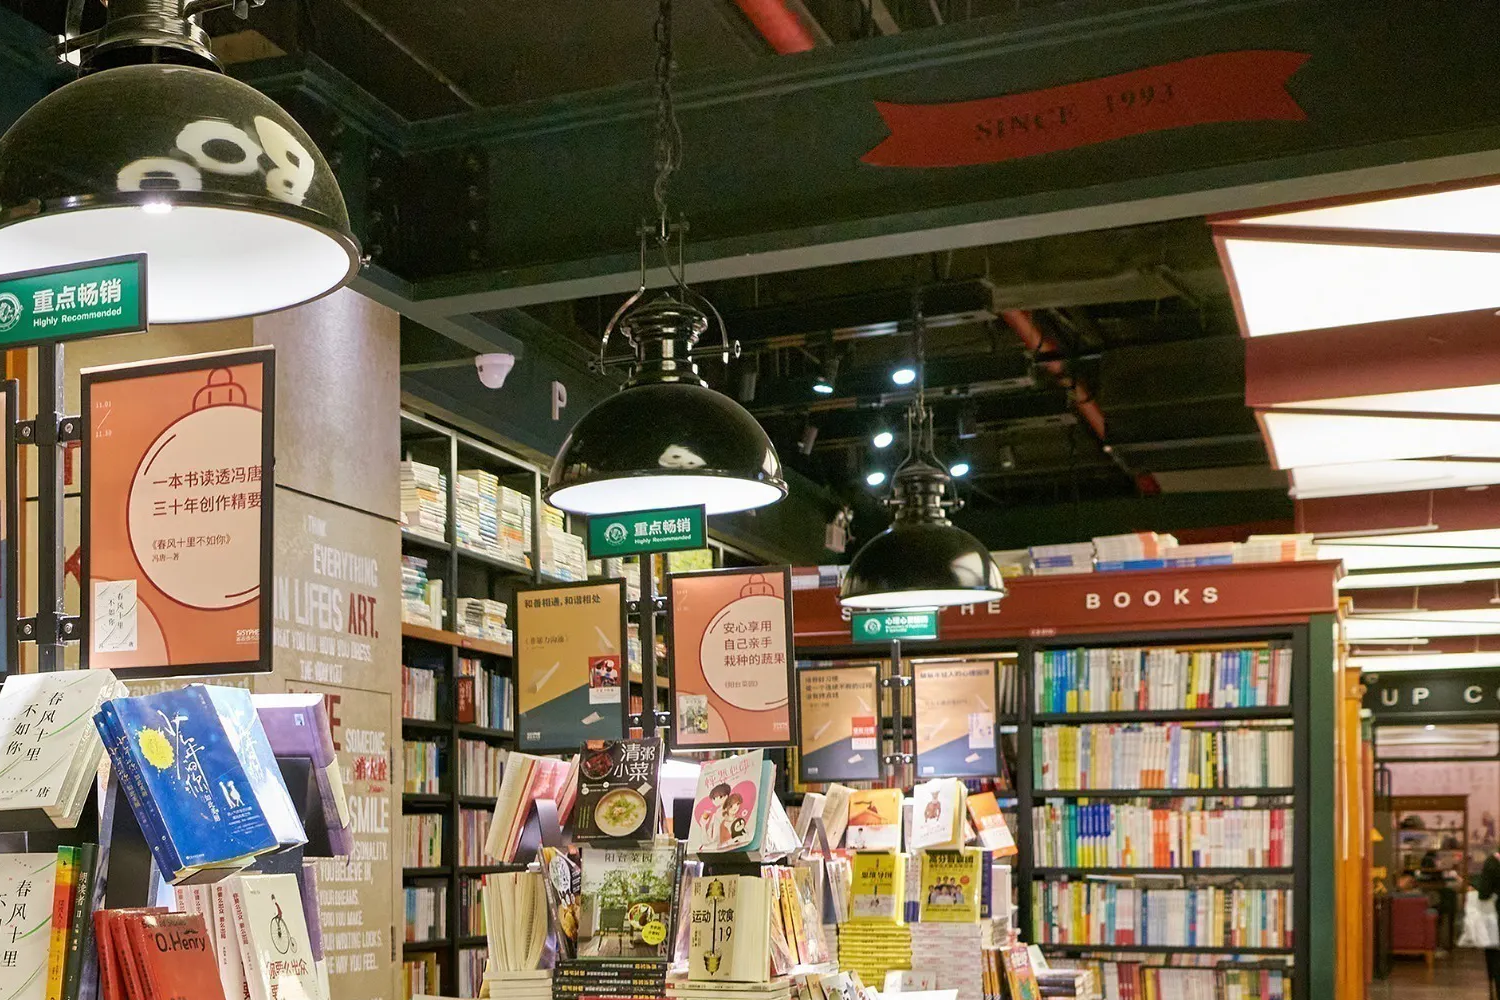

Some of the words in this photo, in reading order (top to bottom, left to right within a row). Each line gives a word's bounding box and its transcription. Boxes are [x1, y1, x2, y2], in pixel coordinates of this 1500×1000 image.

[33, 278, 122, 314] 重点畅销
[33, 316, 58, 328] Highly
[61, 307, 122, 323] Recommended
[551, 381, 567, 420] P
[153, 465, 262, 490] 一本书读透冯唐
[153, 492, 262, 516] 三十年创作精要
[634, 517, 691, 537] 重点畅销
[152, 533, 232, 551] 《春风十里不如你》
[634, 537, 651, 545] Highly
[652, 534, 691, 543] Recommended
[313, 543, 378, 588] EVERYTHING
[274, 575, 290, 622] IN
[348, 592, 379, 639] ART.
[1086, 587, 1218, 609] BOOKS
[723, 621, 772, 634] 安心享用
[724, 637, 772, 651] 自己亲手
[724, 653, 785, 667] 栽种的蔬果
[1381, 687, 1430, 706] UP
[620, 743, 656, 762] 清粥
[355, 756, 387, 781] 消火栓
[613, 763, 649, 782] 小菜
[36, 786, 51, 798] 唐
[350, 796, 390, 834] SMILE
[349, 840, 388, 861] RSONALITY.
[1, 879, 32, 967] 春风十里
[692, 910, 711, 924] 运动
[717, 908, 734, 922] 饮食
[155, 930, 206, 953] O.Henry
[719, 926, 732, 942] 19
